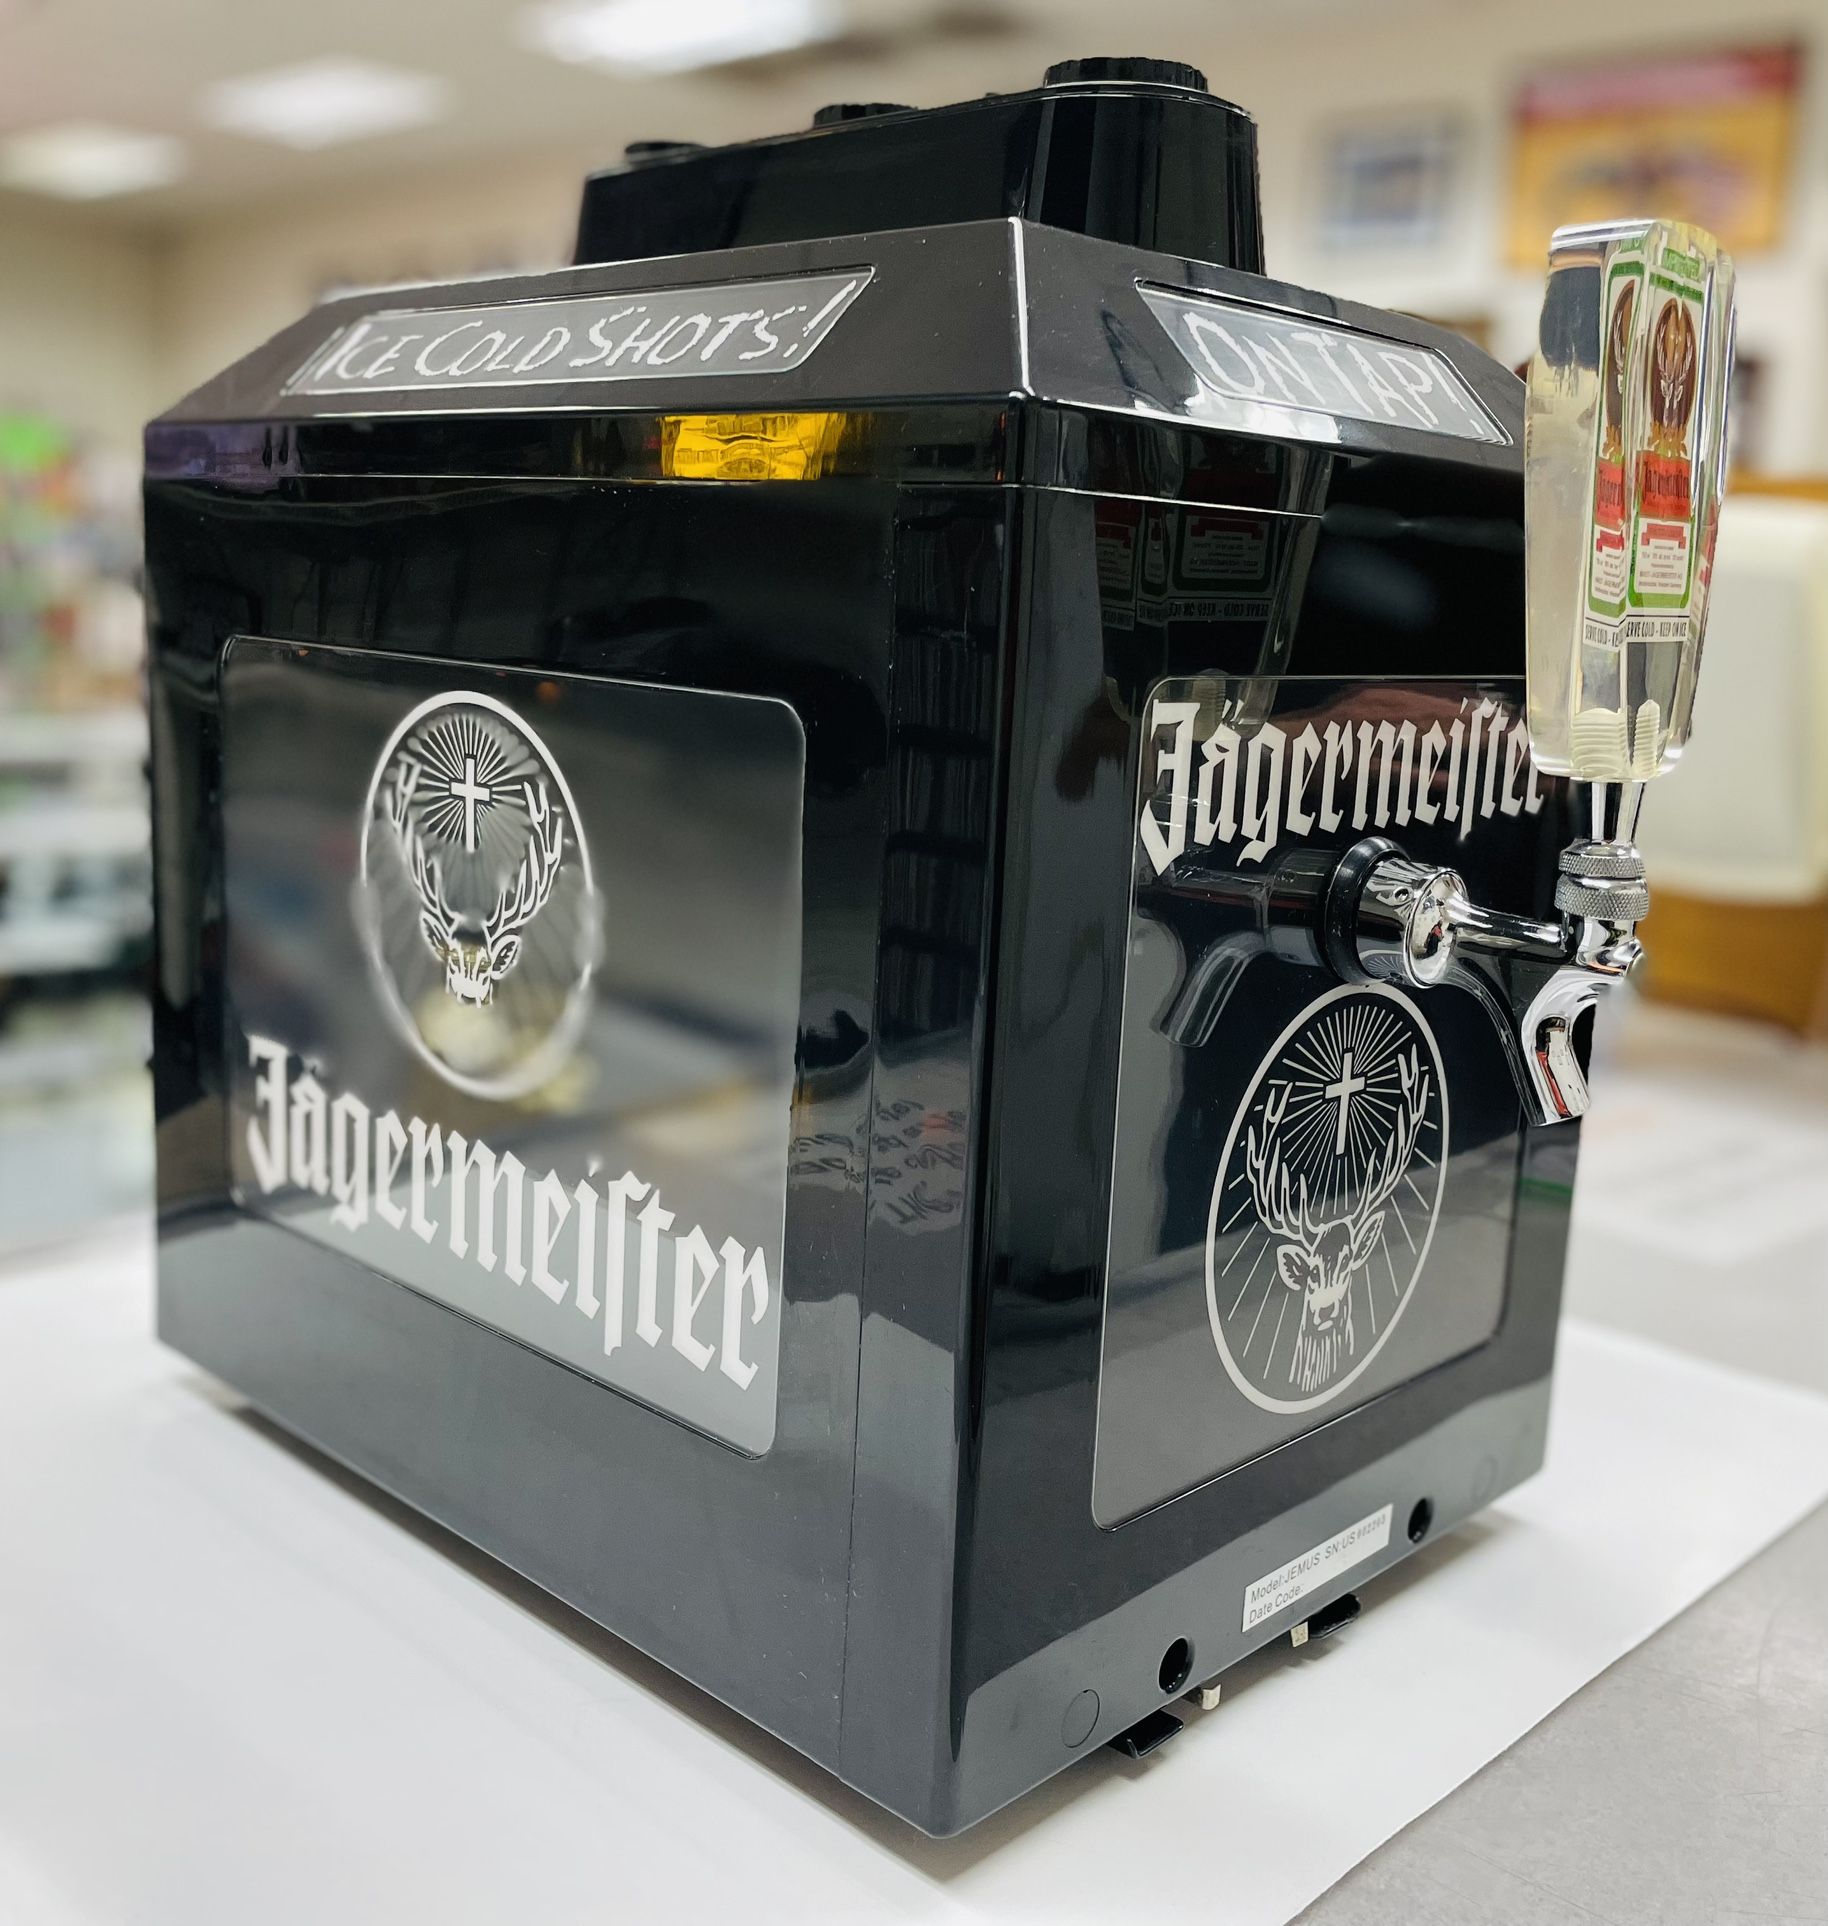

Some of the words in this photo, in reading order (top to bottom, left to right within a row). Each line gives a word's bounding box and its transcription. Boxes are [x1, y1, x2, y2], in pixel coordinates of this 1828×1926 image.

[313, 323, 421, 381] ICE
[413, 321, 570, 377] COLD
[569, 280, 857, 368] SHOTS!
[1182, 311, 1326, 405] ON
[1290, 331, 1484, 436] TAP!
[1641, 621, 1655, 638] COLD
[1659, 621, 1672, 638] KEEP
[1249, 1602, 1273, 1624] Date
